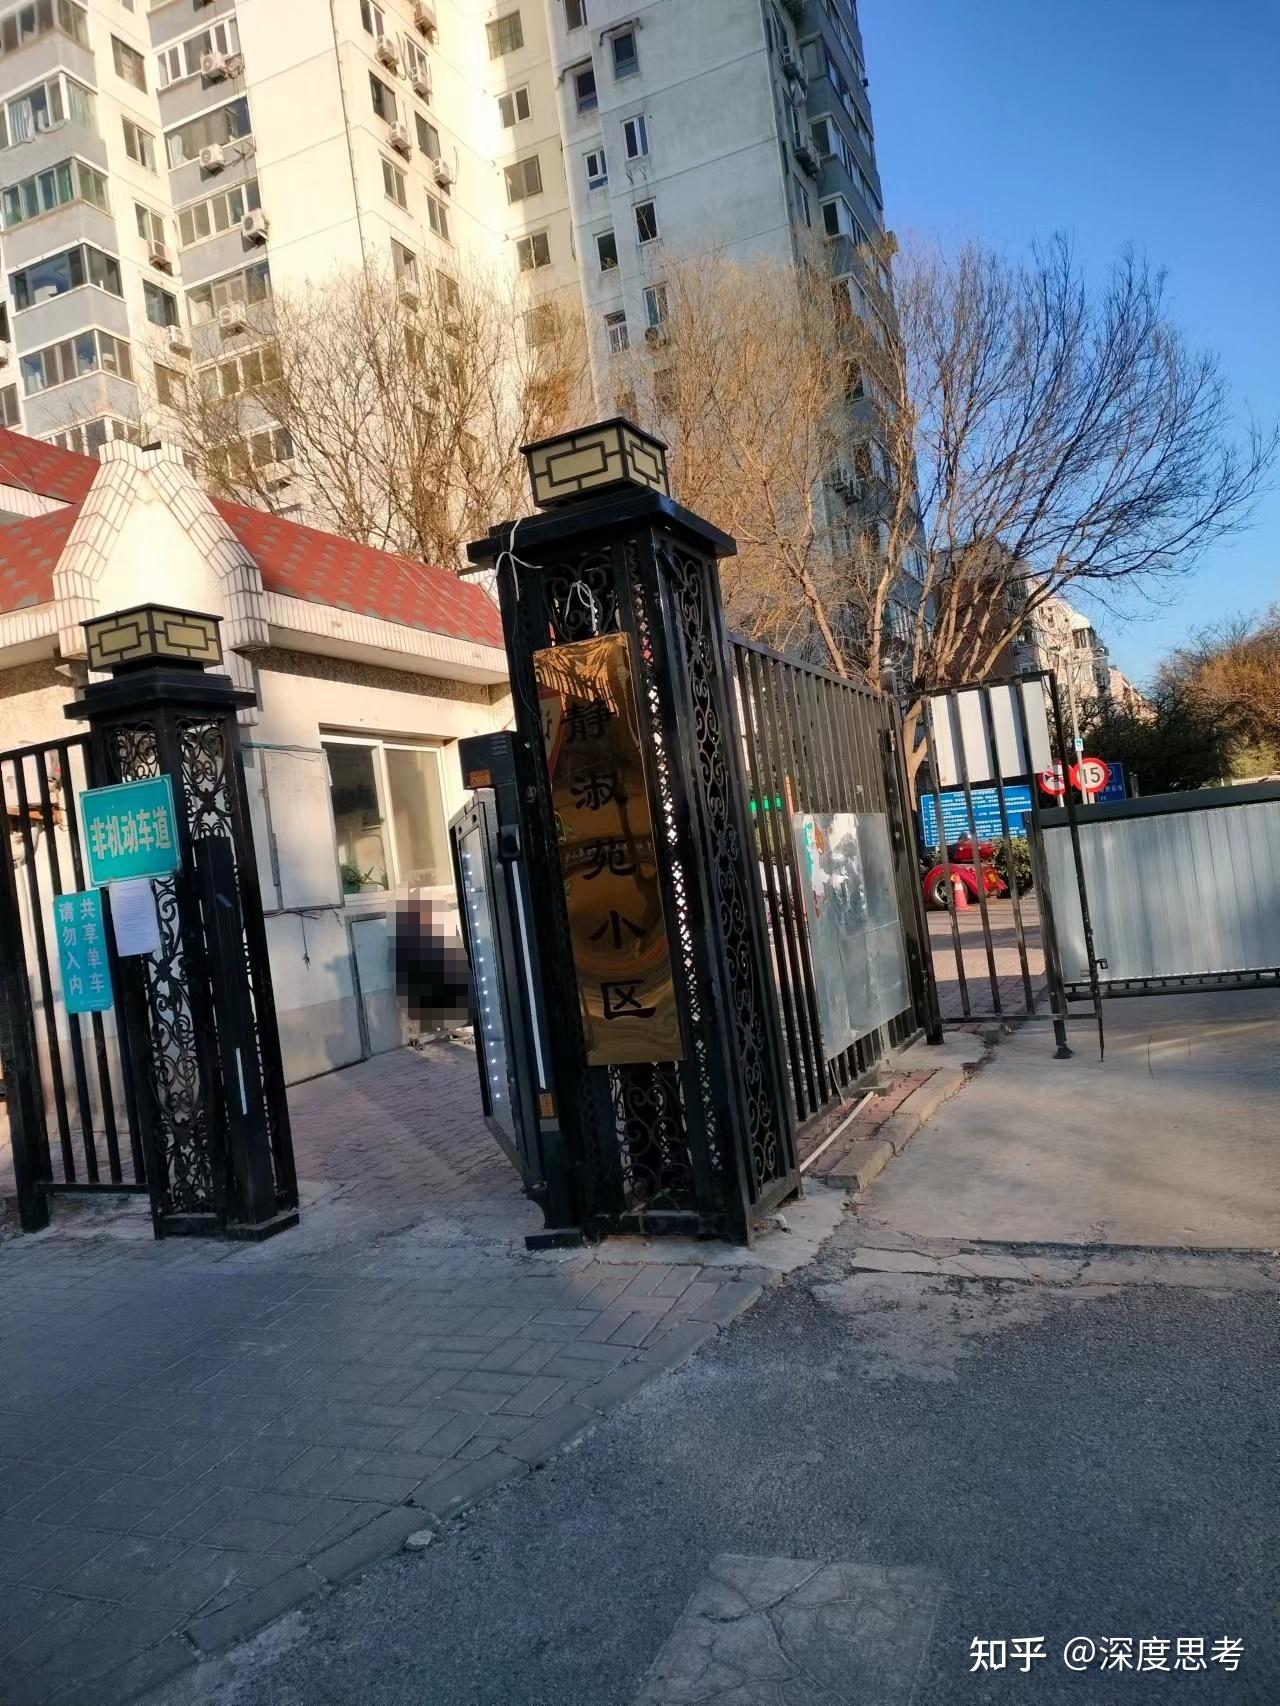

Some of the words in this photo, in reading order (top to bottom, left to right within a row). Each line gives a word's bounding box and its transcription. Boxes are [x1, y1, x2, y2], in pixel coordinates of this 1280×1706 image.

[1081, 766, 1101, 785] 15
[90, 804, 171, 860] 非机动车道
[560, 698, 657, 1020] 静淑苑小区
[58, 901, 84, 996] 请勿入内
[80, 898, 105, 994] 共享单车
